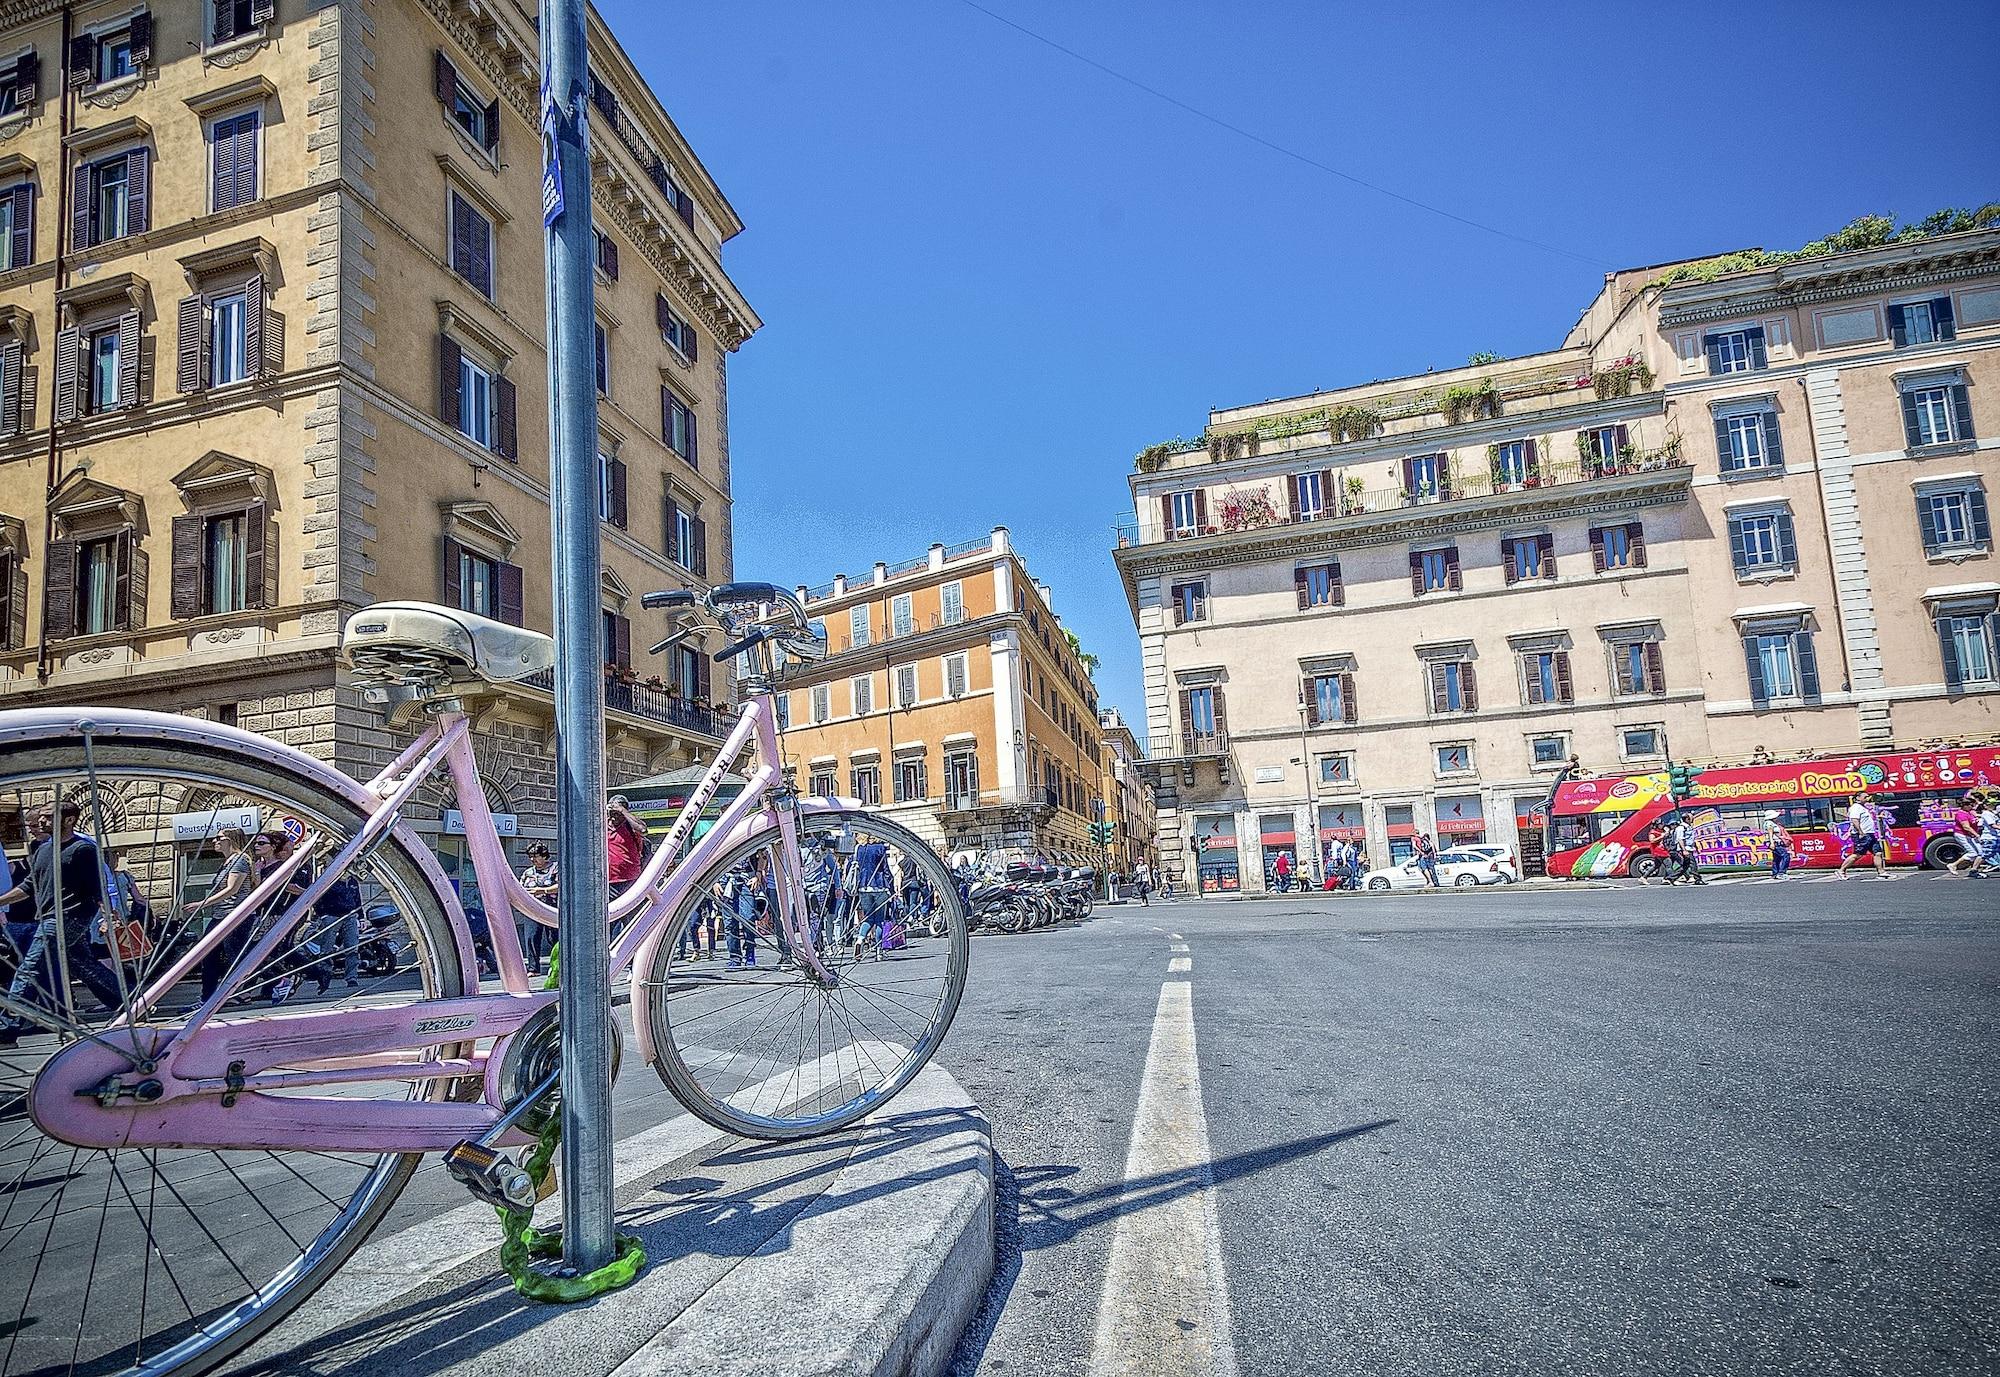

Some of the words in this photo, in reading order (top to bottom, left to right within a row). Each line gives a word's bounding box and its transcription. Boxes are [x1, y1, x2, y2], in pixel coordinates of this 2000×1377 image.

[1803, 773, 1865, 792] Roma
[673, 758, 730, 842] WELTER
[178, 823, 213, 834] Deutsche
[216, 820, 237, 830] Bank
